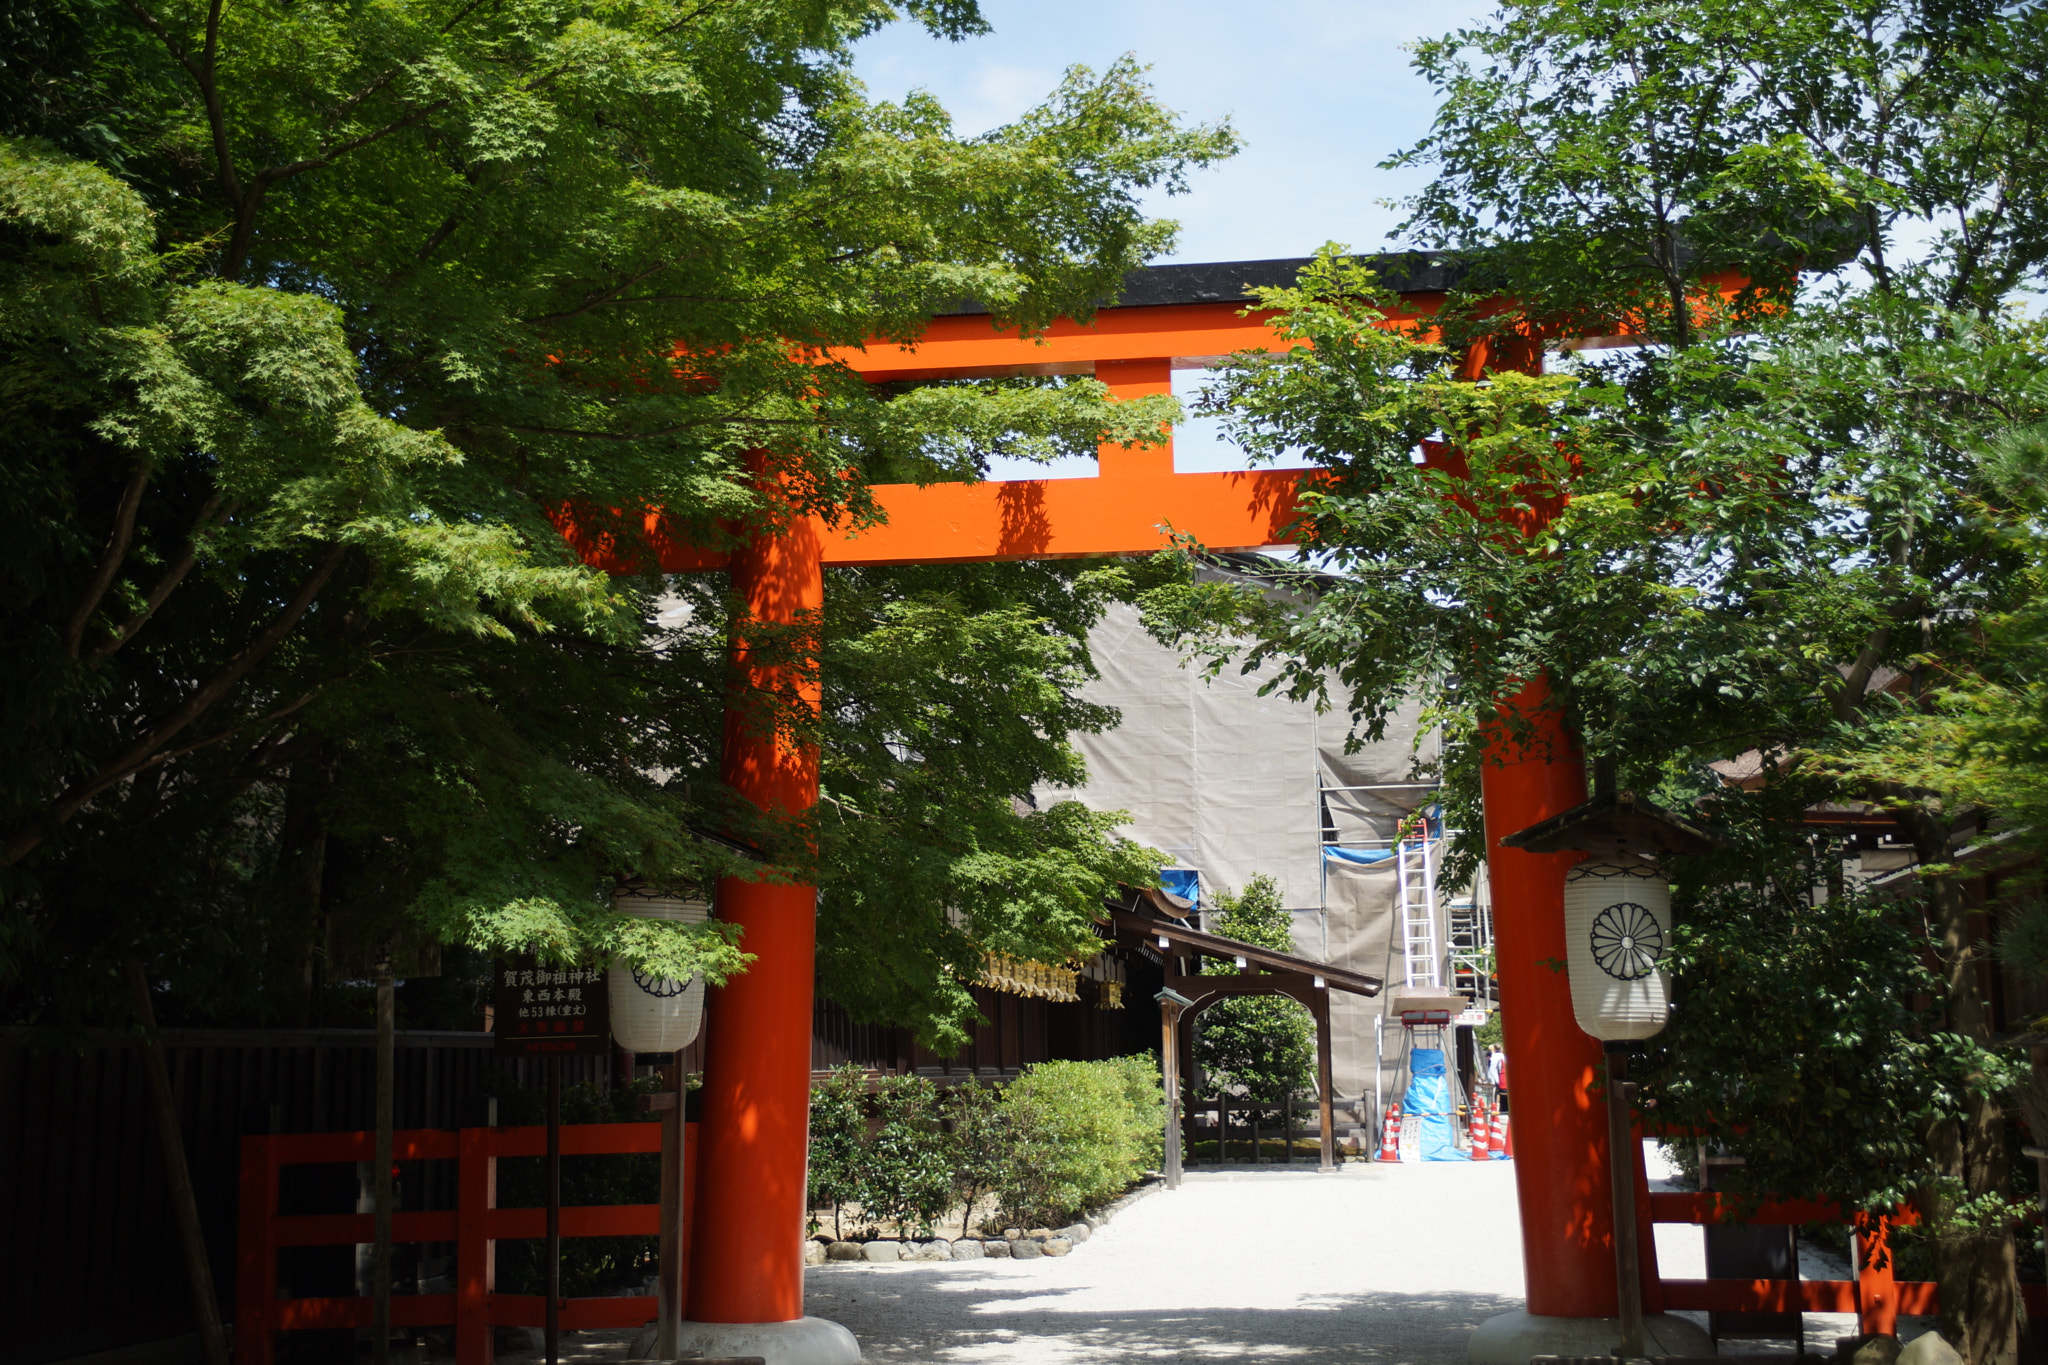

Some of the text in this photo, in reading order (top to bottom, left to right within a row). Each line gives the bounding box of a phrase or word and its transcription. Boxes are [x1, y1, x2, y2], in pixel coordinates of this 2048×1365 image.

[504, 968, 601, 987] 賀茂御祖神社
[522, 988, 582, 1002] 東西本殿
[526, 1041, 576, 1051] HITACHI
